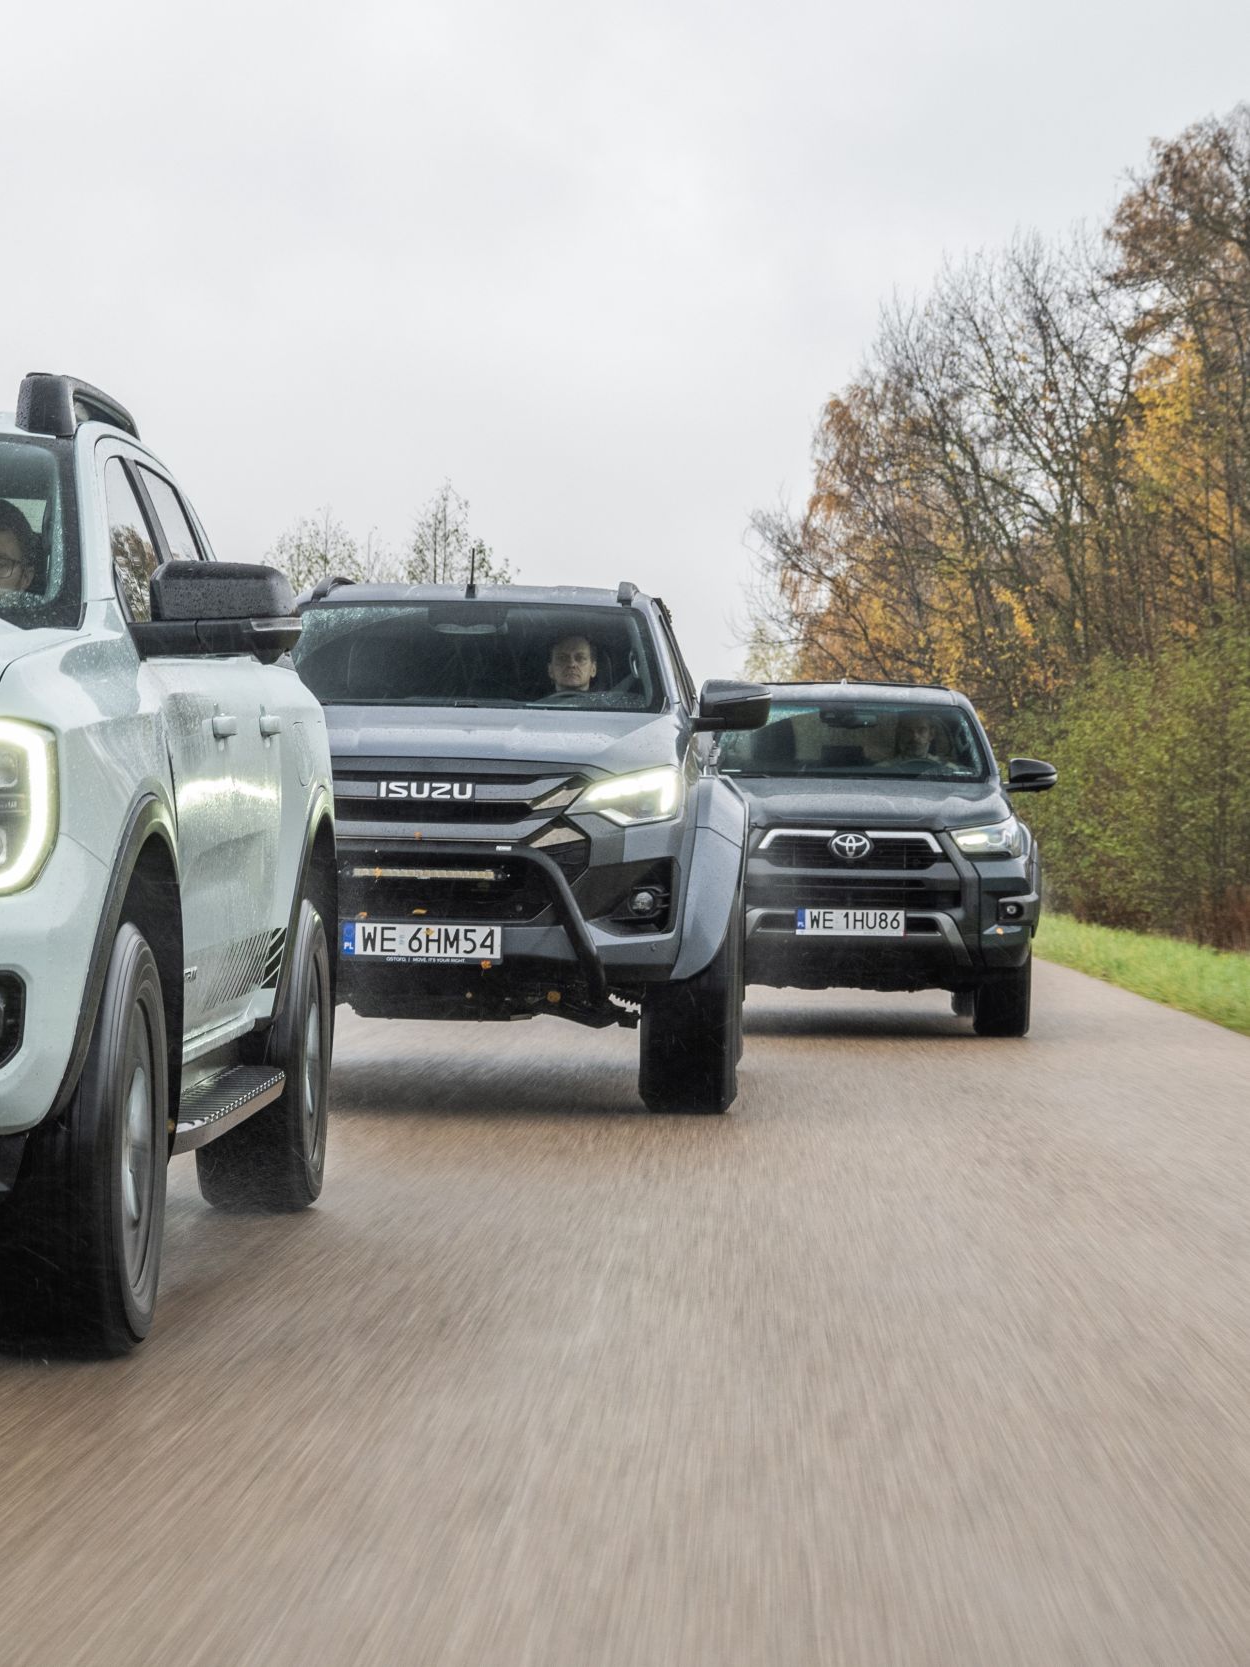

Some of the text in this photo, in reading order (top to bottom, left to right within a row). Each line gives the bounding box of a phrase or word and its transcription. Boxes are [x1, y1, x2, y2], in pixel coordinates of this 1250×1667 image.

[379, 781, 473, 799] ISUZU
[810, 911, 901, 930] WE 1HU86
[344, 942, 354, 950] PL
[362, 926, 495, 955] WE 6HM54
